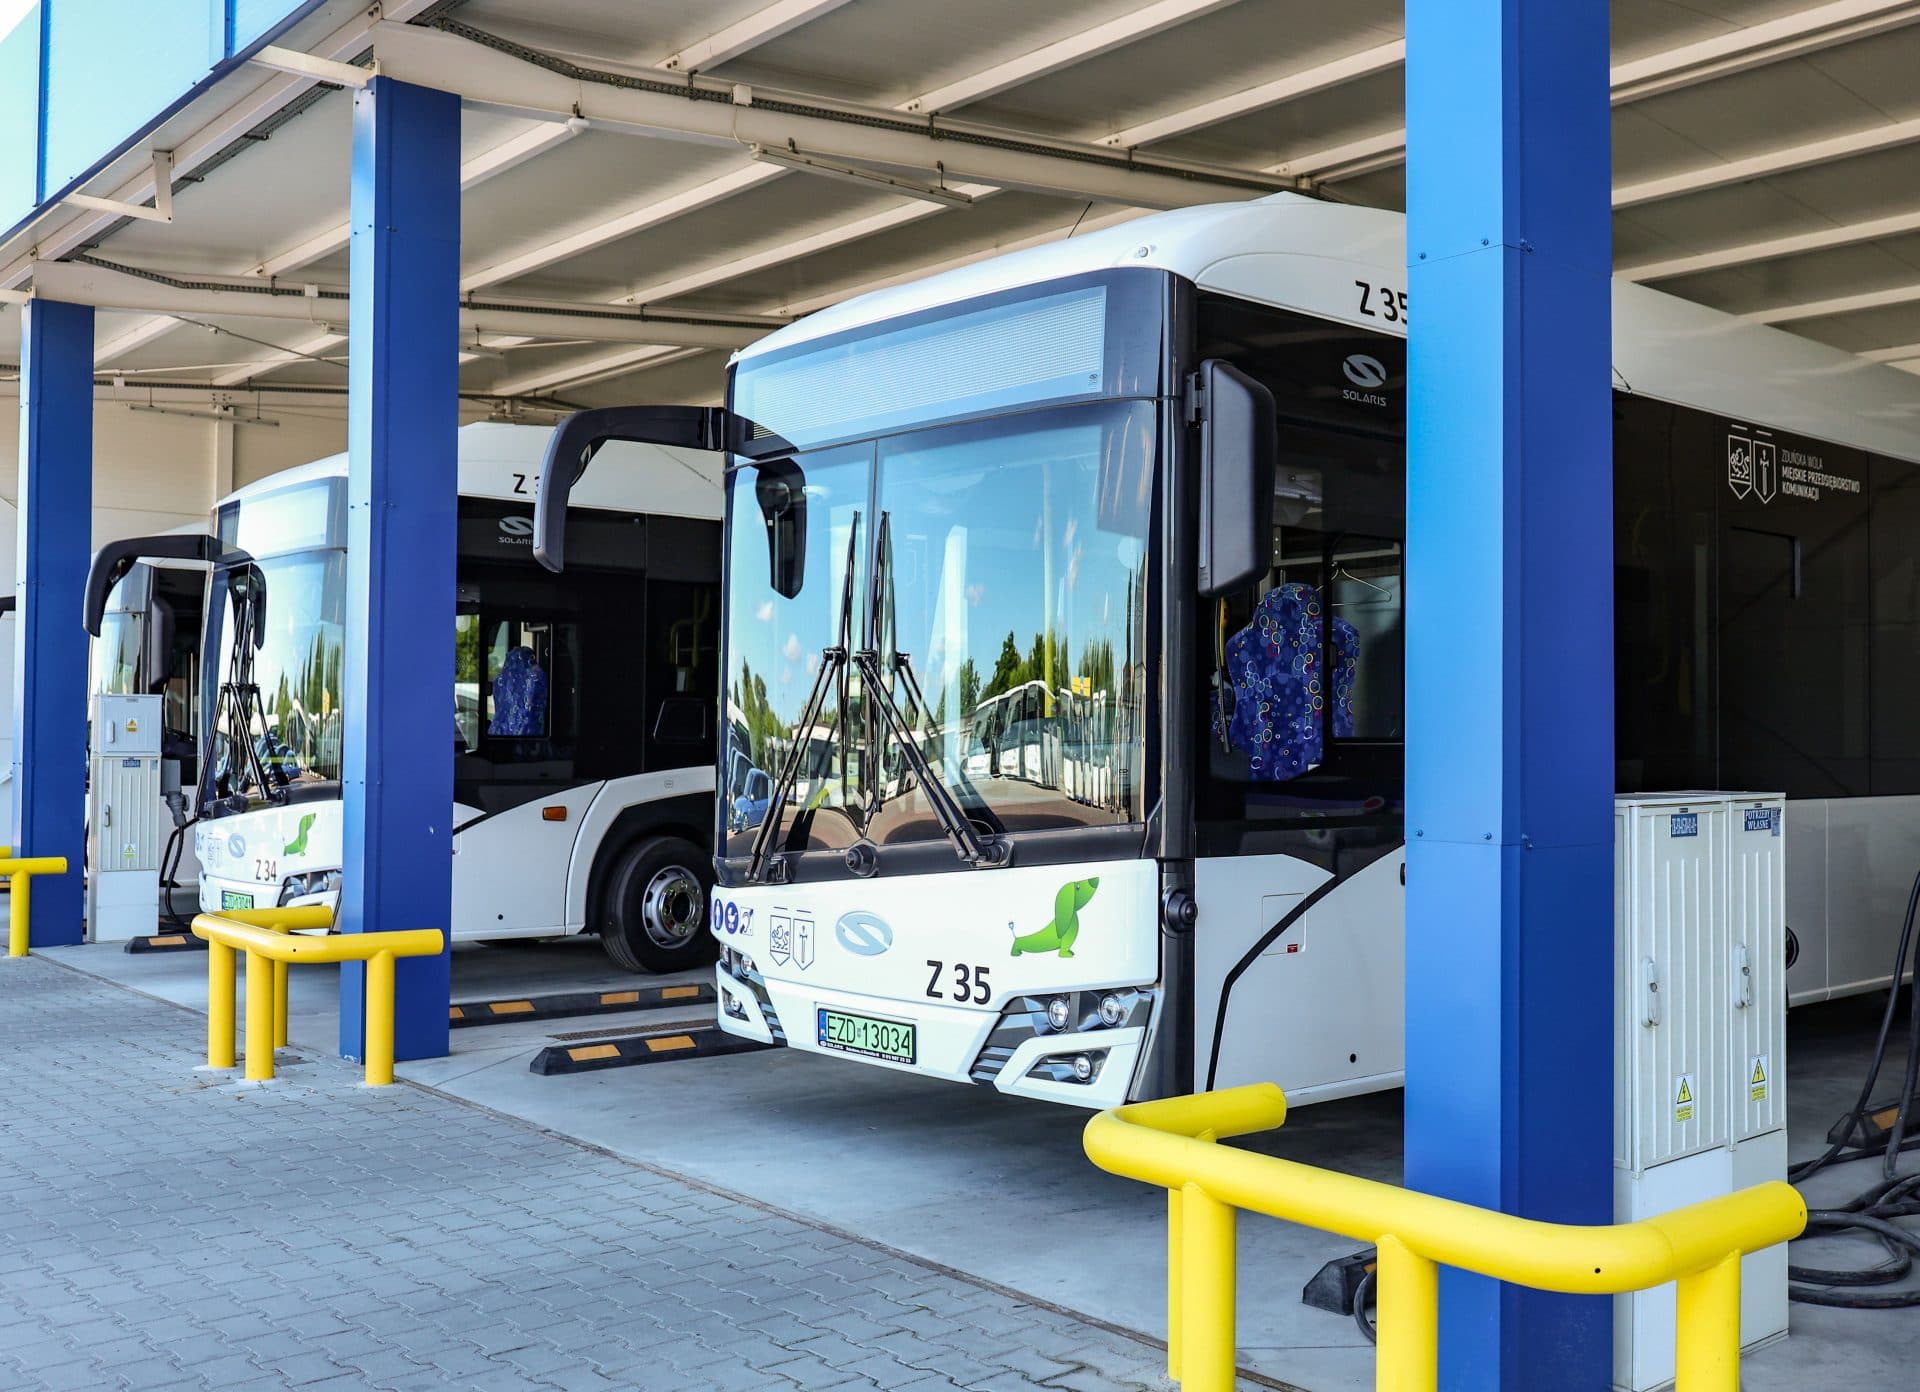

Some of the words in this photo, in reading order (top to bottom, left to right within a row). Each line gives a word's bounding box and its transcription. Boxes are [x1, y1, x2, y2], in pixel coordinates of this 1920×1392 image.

[1355, 280, 1376, 316] Z
[1343, 389, 1387, 407] SOLARIS
[1807, 455, 1823, 470] WOLA
[513, 473, 527, 495] Z
[1782, 465, 1807, 482] MIEJSKIE
[1782, 481, 1820, 501] KOMUNIKACJI
[498, 535, 533, 546] SOLARI
[255, 859, 262, 880] Z
[264, 860, 277, 882] 34
[926, 959, 943, 999] Z
[953, 963, 992, 1005] 35
[827, 1015, 856, 1044] EZD
[862, 1021, 911, 1057] 13034
